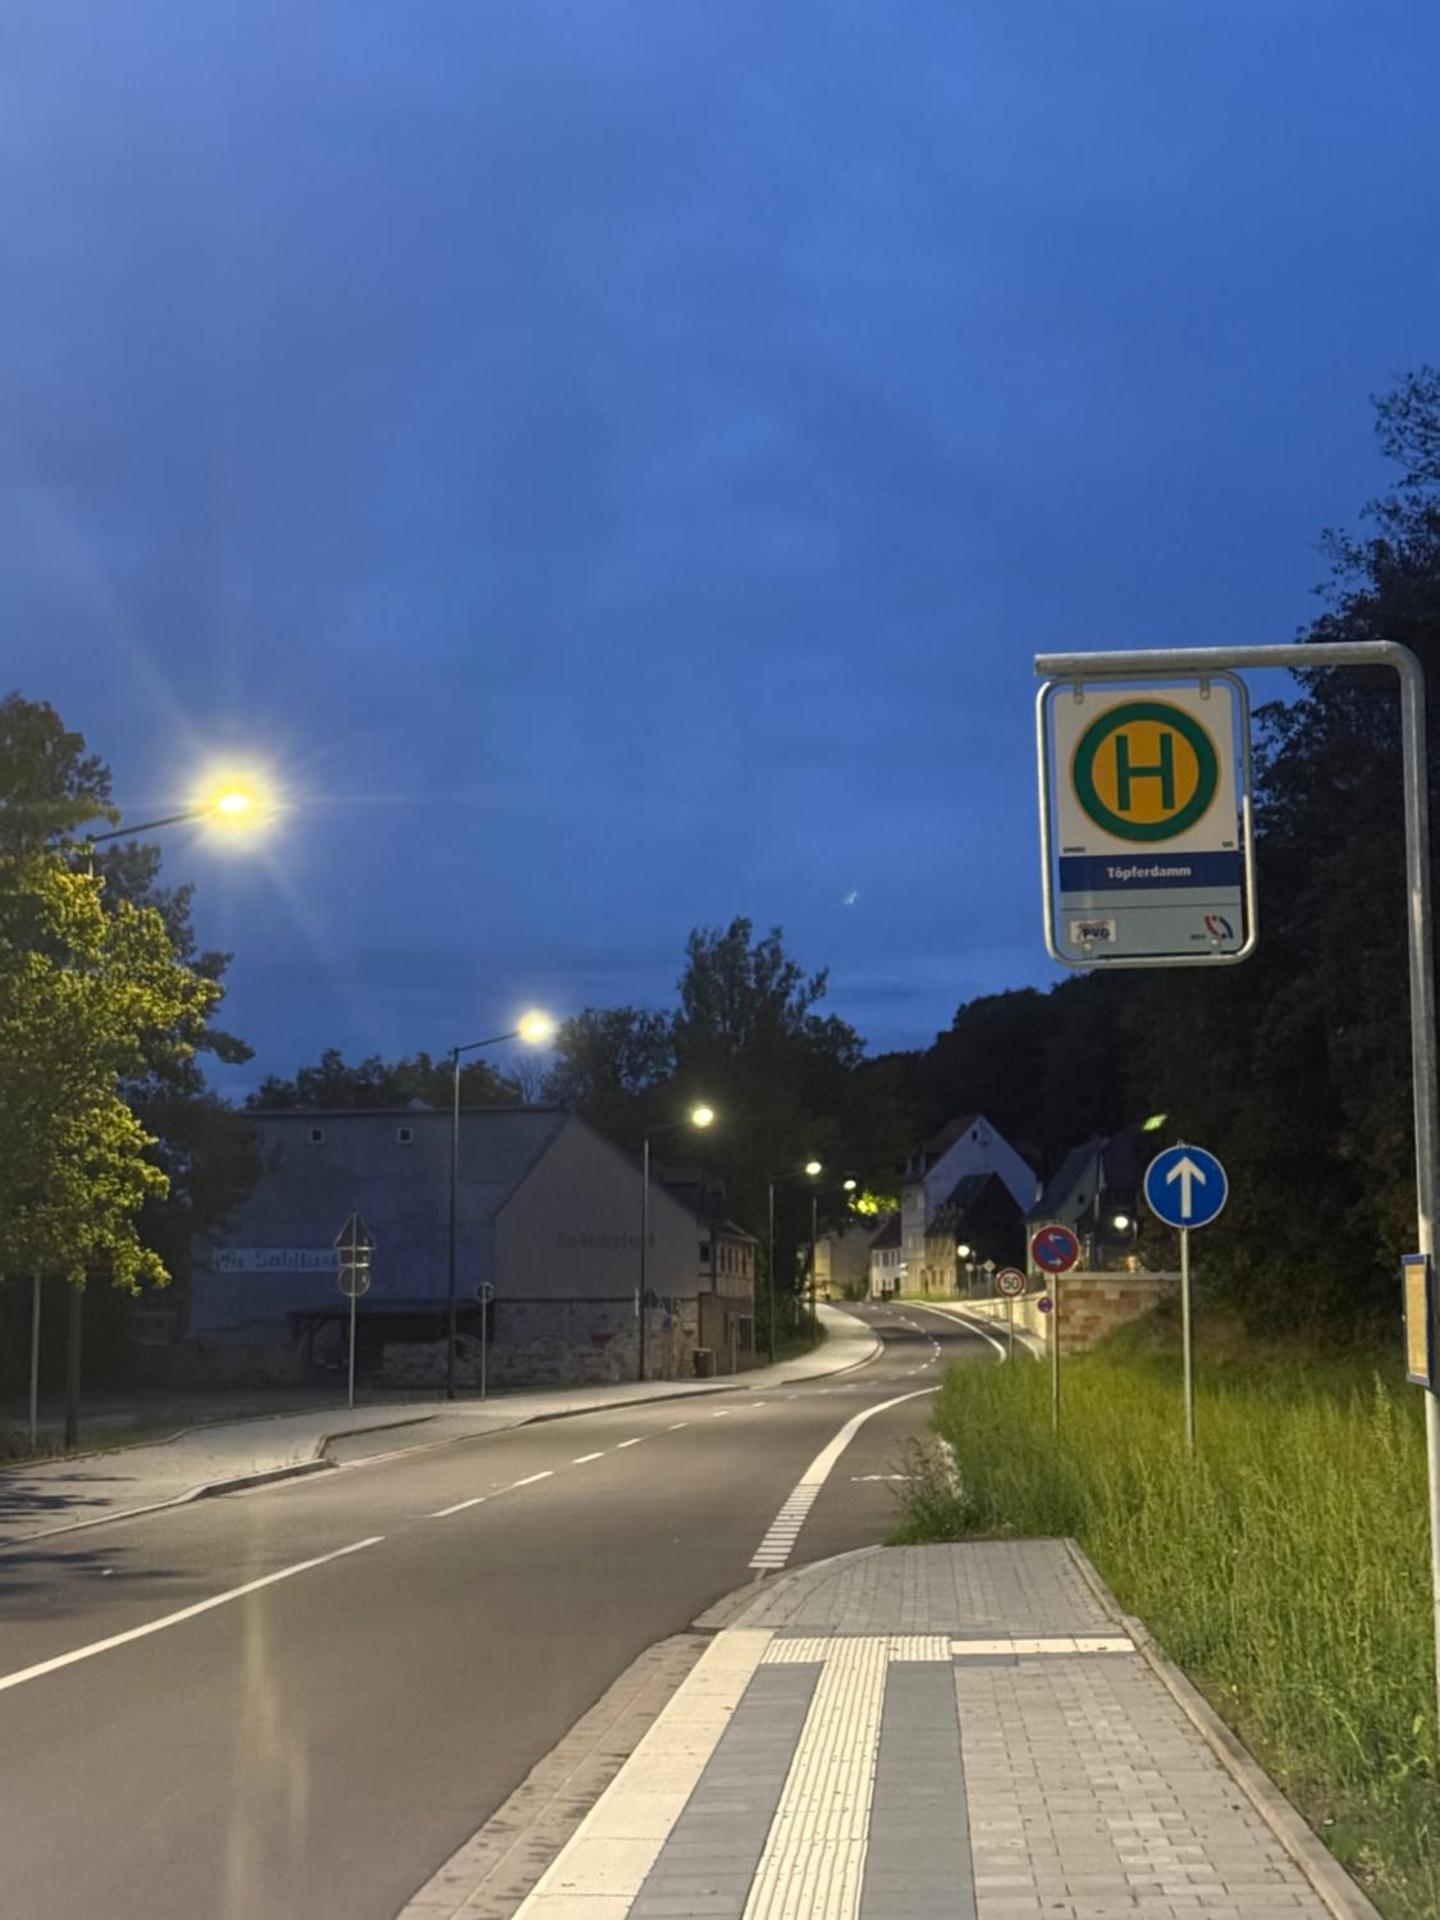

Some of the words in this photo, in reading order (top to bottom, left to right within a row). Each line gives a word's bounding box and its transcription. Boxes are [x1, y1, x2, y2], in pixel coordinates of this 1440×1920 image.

[1115, 732, 1175, 811] H
[1106, 865, 1192, 881] Töpferdamm
[1003, 1276, 1020, 1290] 50
